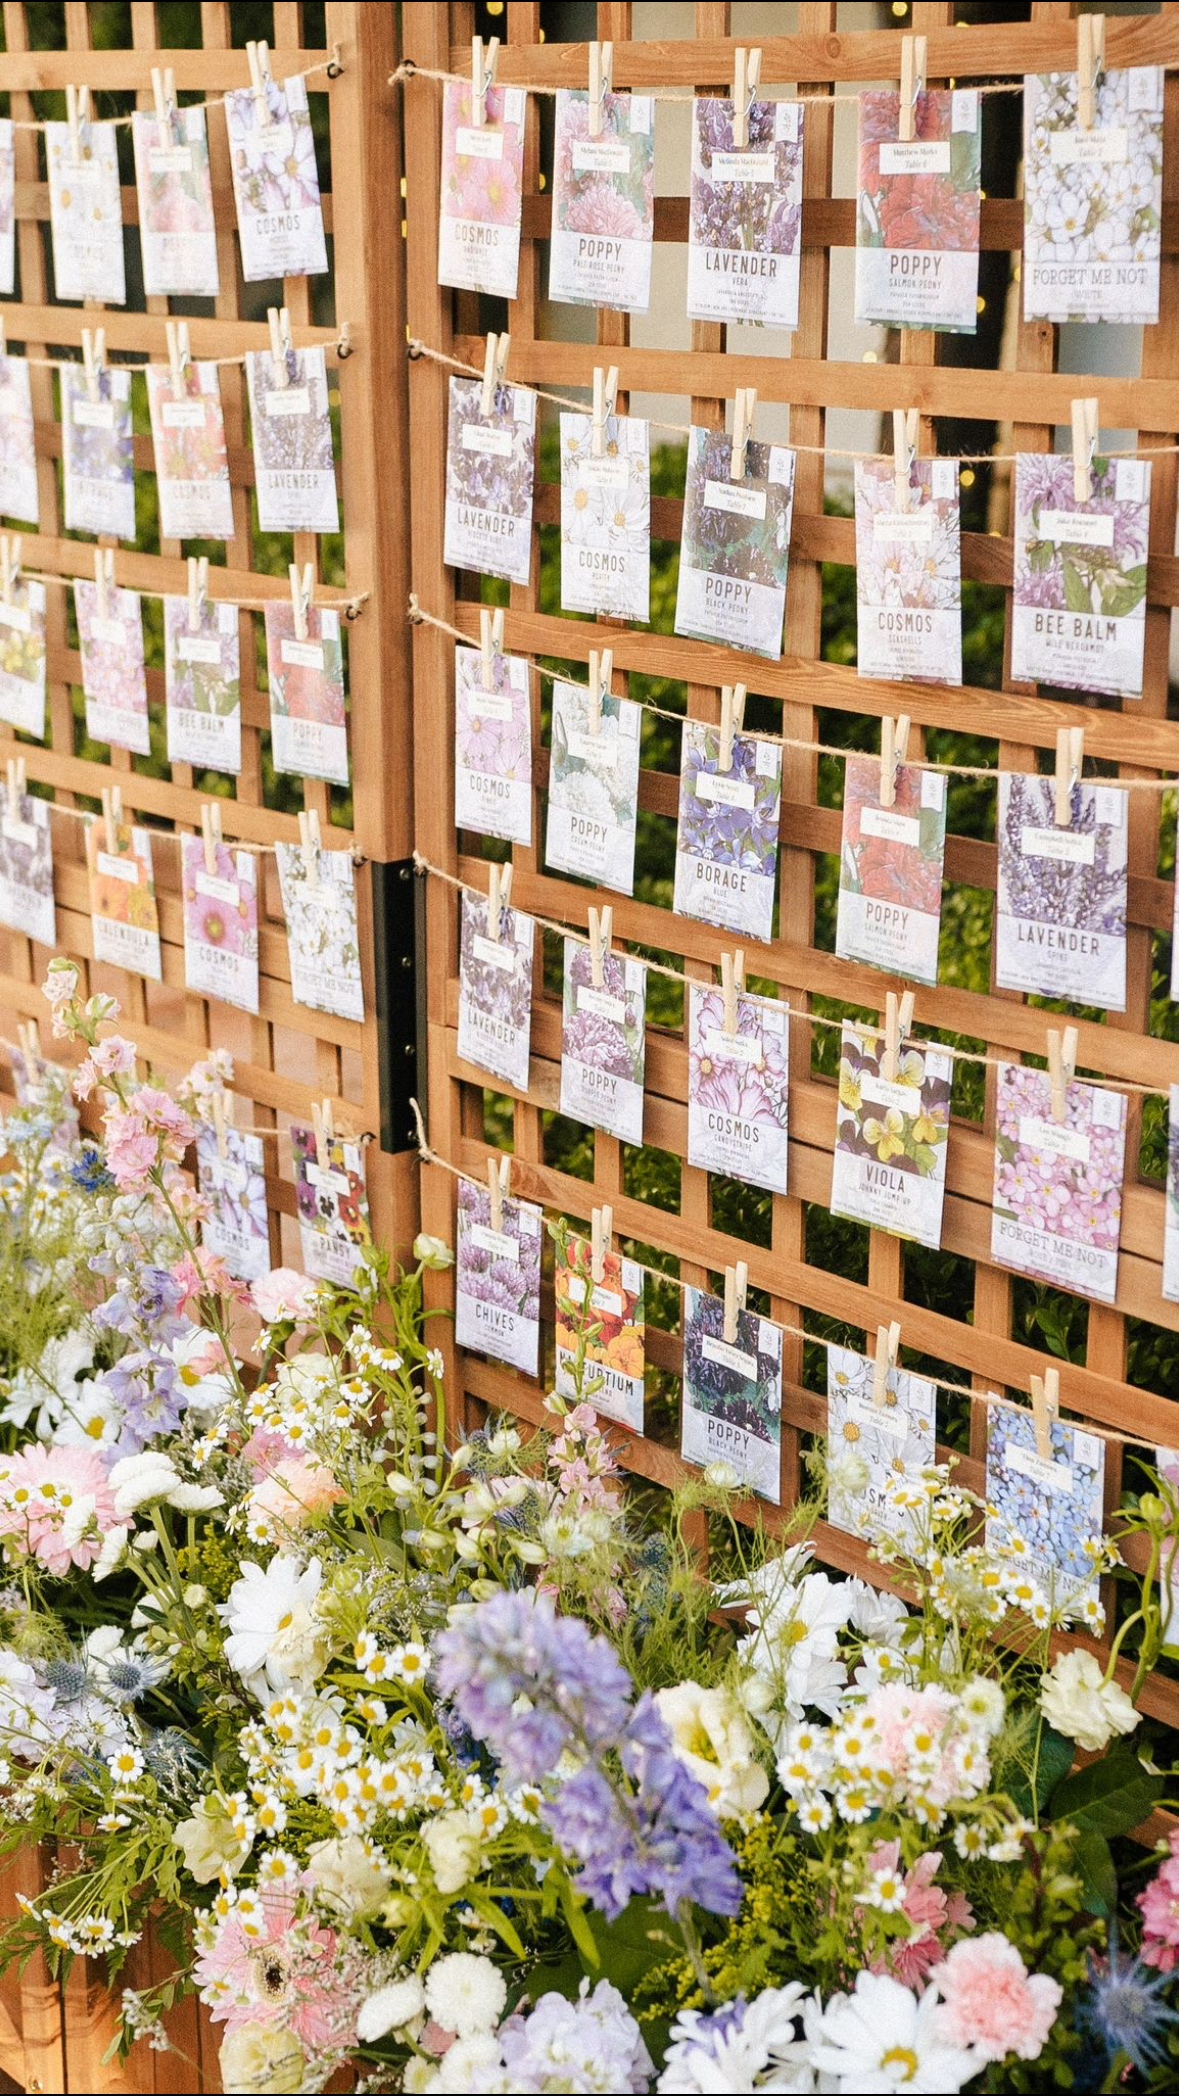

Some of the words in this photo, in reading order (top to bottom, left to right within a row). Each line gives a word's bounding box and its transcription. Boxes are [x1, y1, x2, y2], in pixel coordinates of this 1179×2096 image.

[905, 160, 922, 169] Table
[256, 214, 300, 235] COSMOS
[455, 223, 499, 246] COSMOS
[579, 238, 622, 261] POPPY
[706, 252, 777, 277] LAVENDER
[891, 254, 942, 276] POPPY
[733, 276, 749, 286] VERA
[889, 278, 916, 288] SALMON
[919, 279, 942, 290] PEONY
[1033, 268, 1087, 286] FORGET
[1091, 269, 1111, 285] ME
[1116, 268, 1149, 285] NOT
[268, 473, 319, 489] LAVENDER
[457, 507, 516, 539] LAVENDER
[579, 550, 626, 573] COSMOS
[706, 577, 752, 604] POPPY
[706, 598, 725, 611] BLACK
[728, 602, 749, 615] PEONY
[878, 612, 933, 633] COSMOS
[1035, 614, 1064, 635] BEE
[1074, 618, 1117, 641] BALM
[469, 774, 511, 799] COSMOS
[571, 816, 608, 842] POPPY
[696, 862, 747, 893] BORAGE
[713, 887, 728, 898] BLUE
[866, 901, 910, 930] POPPY
[865, 922, 887, 936] SALMON
[888, 927, 908, 941] PEONY
[1018, 923, 1100, 957] LAVENDER
[468, 1010, 516, 1048] LAVENDER
[581, 1067, 618, 1096] POPPY
[708, 1113, 760, 1143] COSMOS
[714, 1133, 753, 1151] CANDYSTRIPE
[858, 1181, 882, 1197] JOHNNY
[866, 1163, 906, 1193] VIOLA
[215, 1226, 250, 1250] COSMOS
[320, 1237, 351, 1260] PANSY
[1000, 1221, 1050, 1250] FORGET
[1053, 1240, 1073, 1257] ME
[1077, 1246, 1107, 1268] NOT
[475, 1303, 515, 1331] CHIVES
[707, 1419, 750, 1450] POPPY
[708, 1437, 728, 1450] BLACK
[729, 1443, 748, 1459] PEONY
